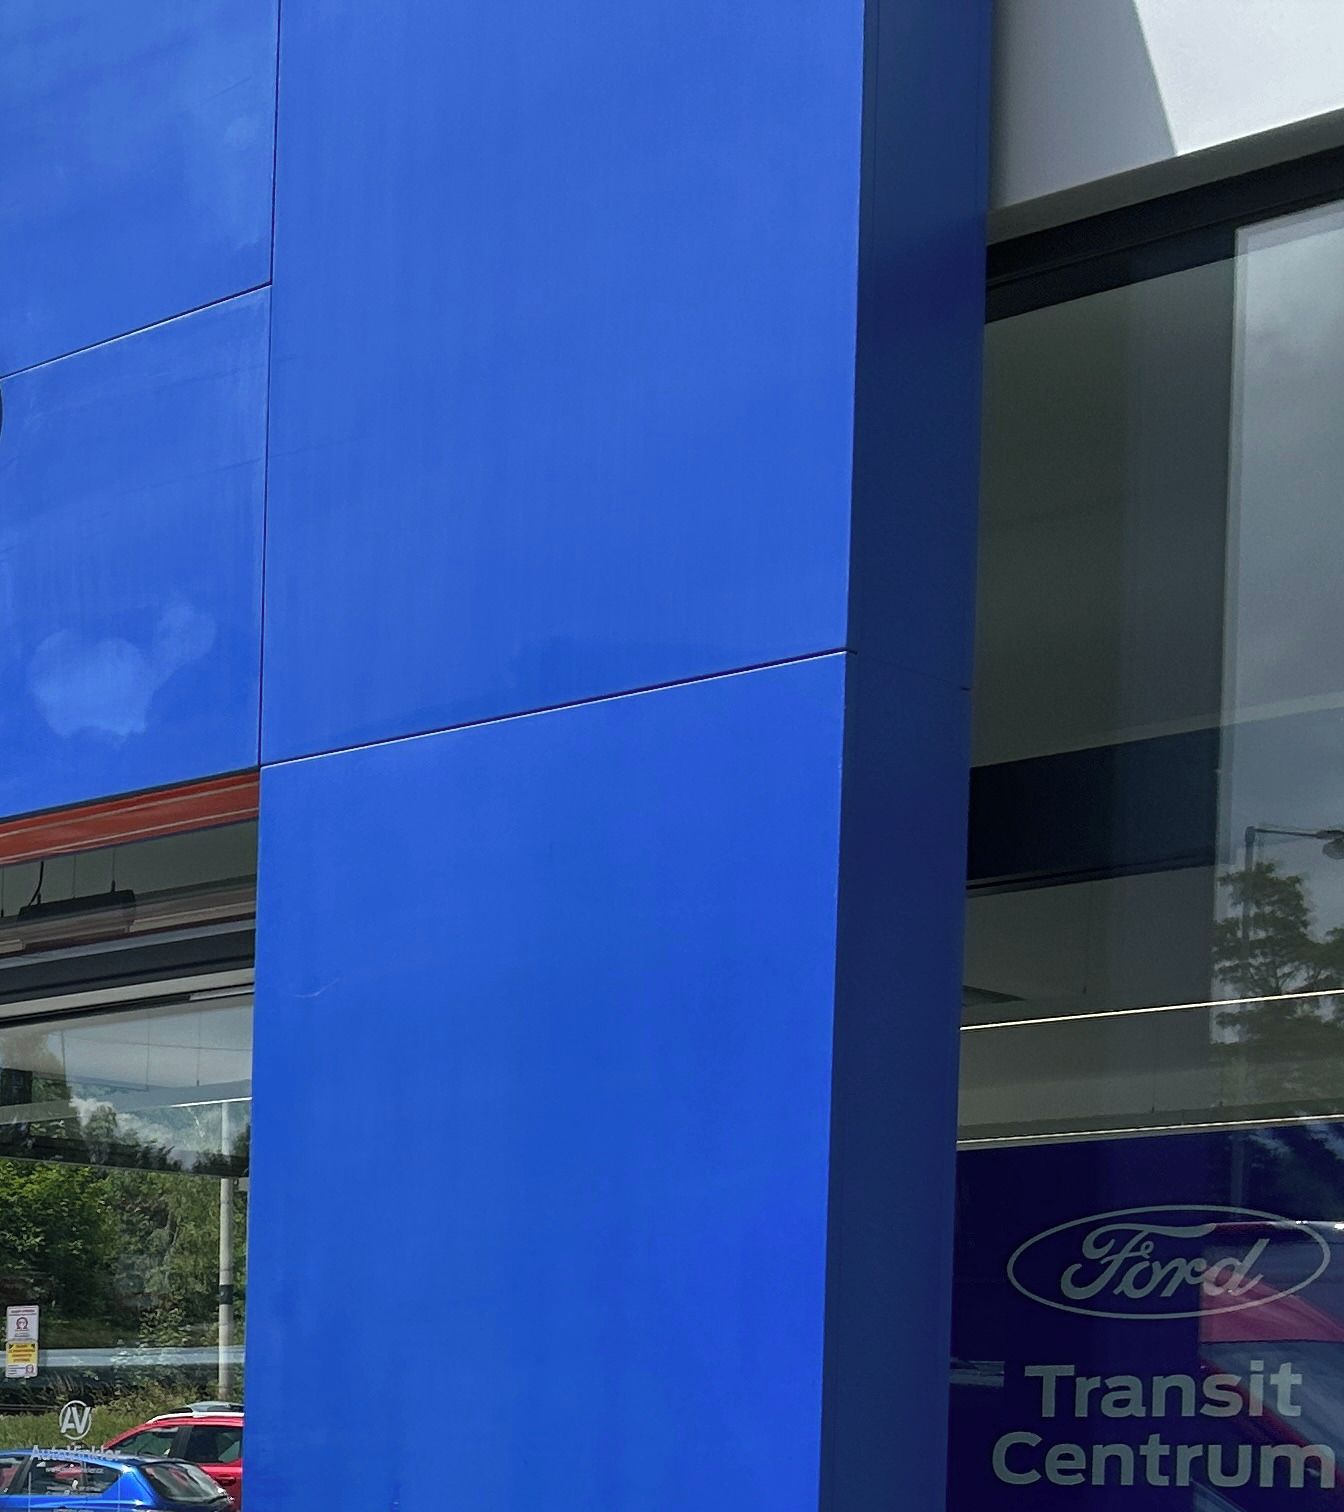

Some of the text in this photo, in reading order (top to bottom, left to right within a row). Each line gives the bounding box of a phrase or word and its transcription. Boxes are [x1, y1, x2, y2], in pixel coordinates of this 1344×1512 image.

[1060, 1223, 1269, 1300] Ford
[1024, 1360, 1303, 1417] Transit
[60, 1406, 91, 1434] AV
[992, 1431, 1336, 1489] Centrum
